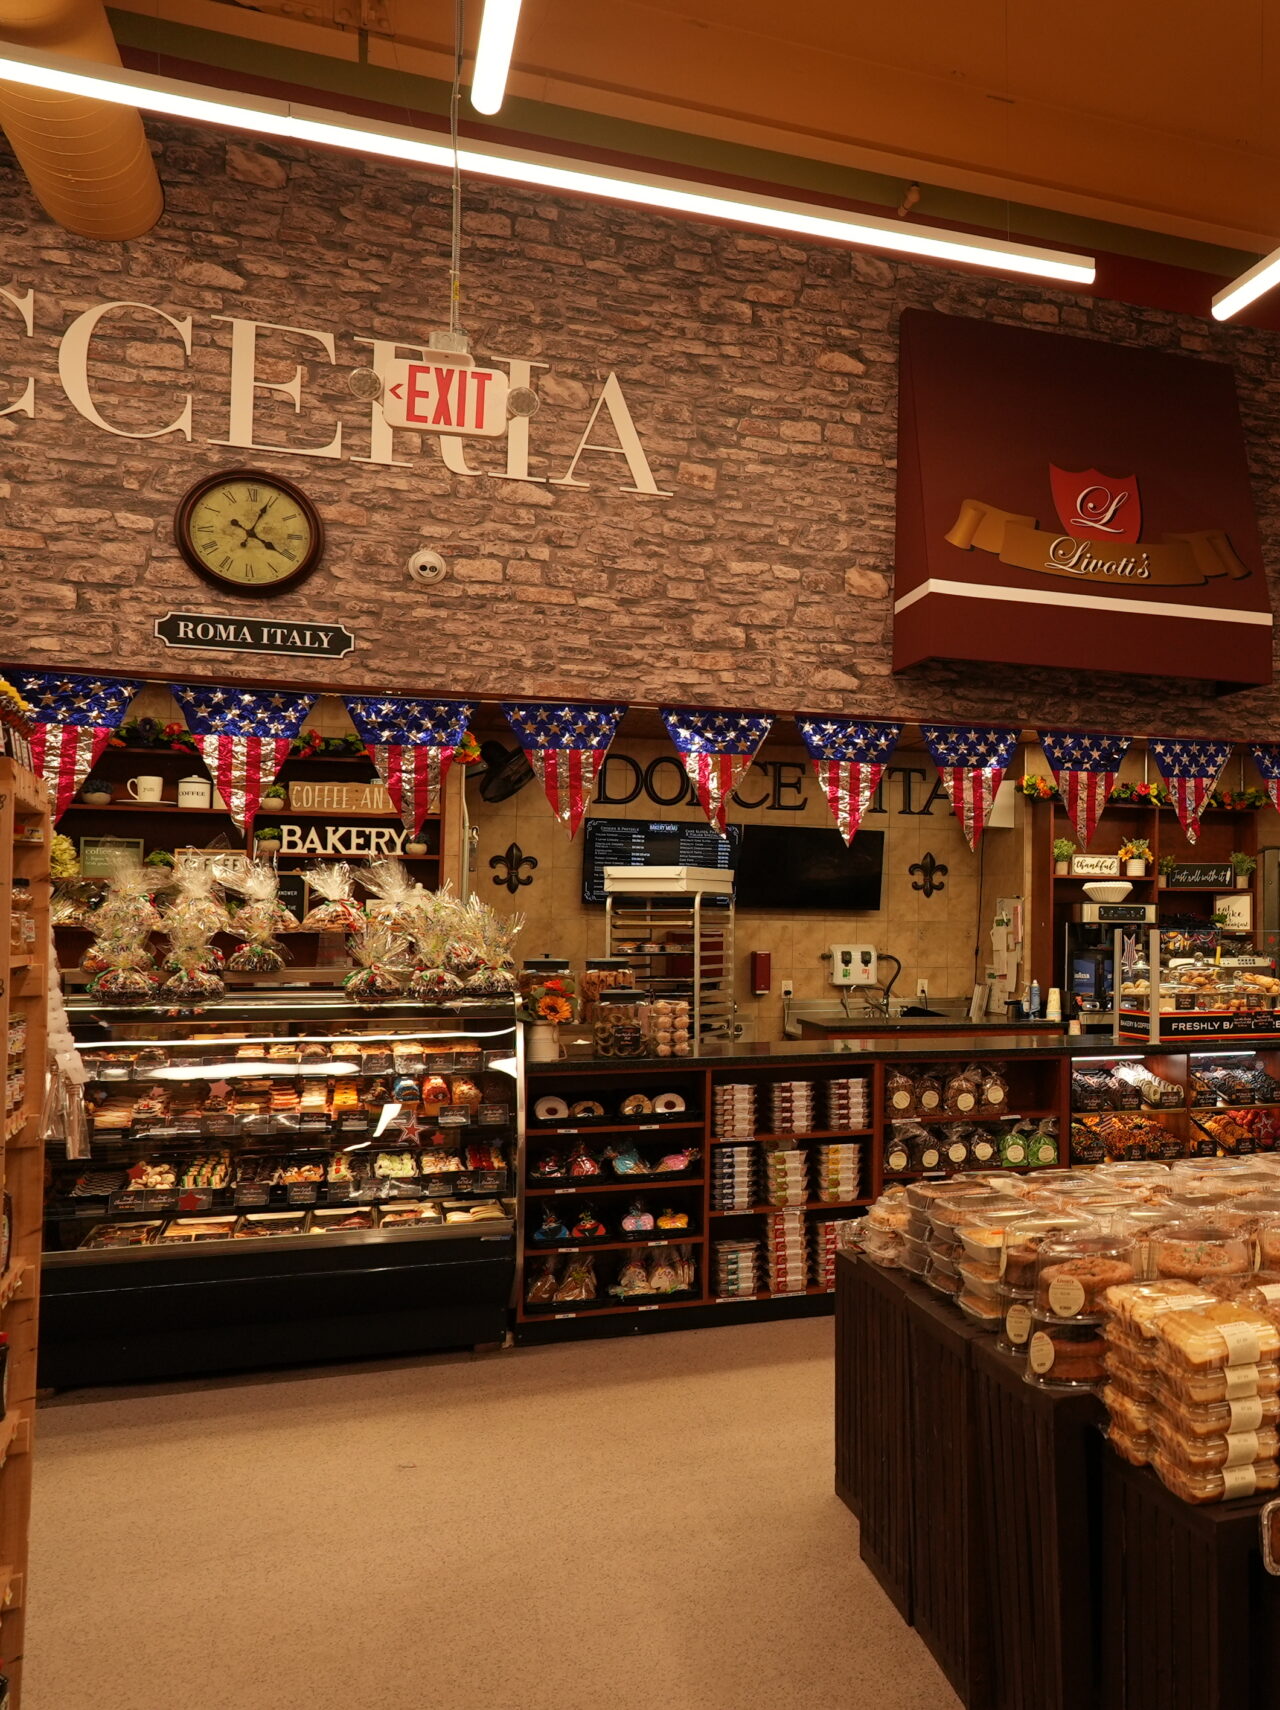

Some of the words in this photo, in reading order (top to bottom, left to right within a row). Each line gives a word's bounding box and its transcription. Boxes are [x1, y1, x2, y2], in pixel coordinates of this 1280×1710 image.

[406, 364, 492, 429] EXIT
[1044, 536, 1151, 578] Livoti's
[177, 621, 254, 643] ROMA
[260, 628, 334, 648] ITALY
[592, 754, 808, 811] DOCE
[292, 785, 356, 810] COFFEE,
[280, 824, 408, 855] BAKERY
[1075, 859, 1115, 871] thankful
[1172, 869, 1188, 882] Just
[1188, 869, 1201, 882] roll
[1201, 869, 1218, 882] with
[1172, 1021, 1220, 1030] FRESHLY
